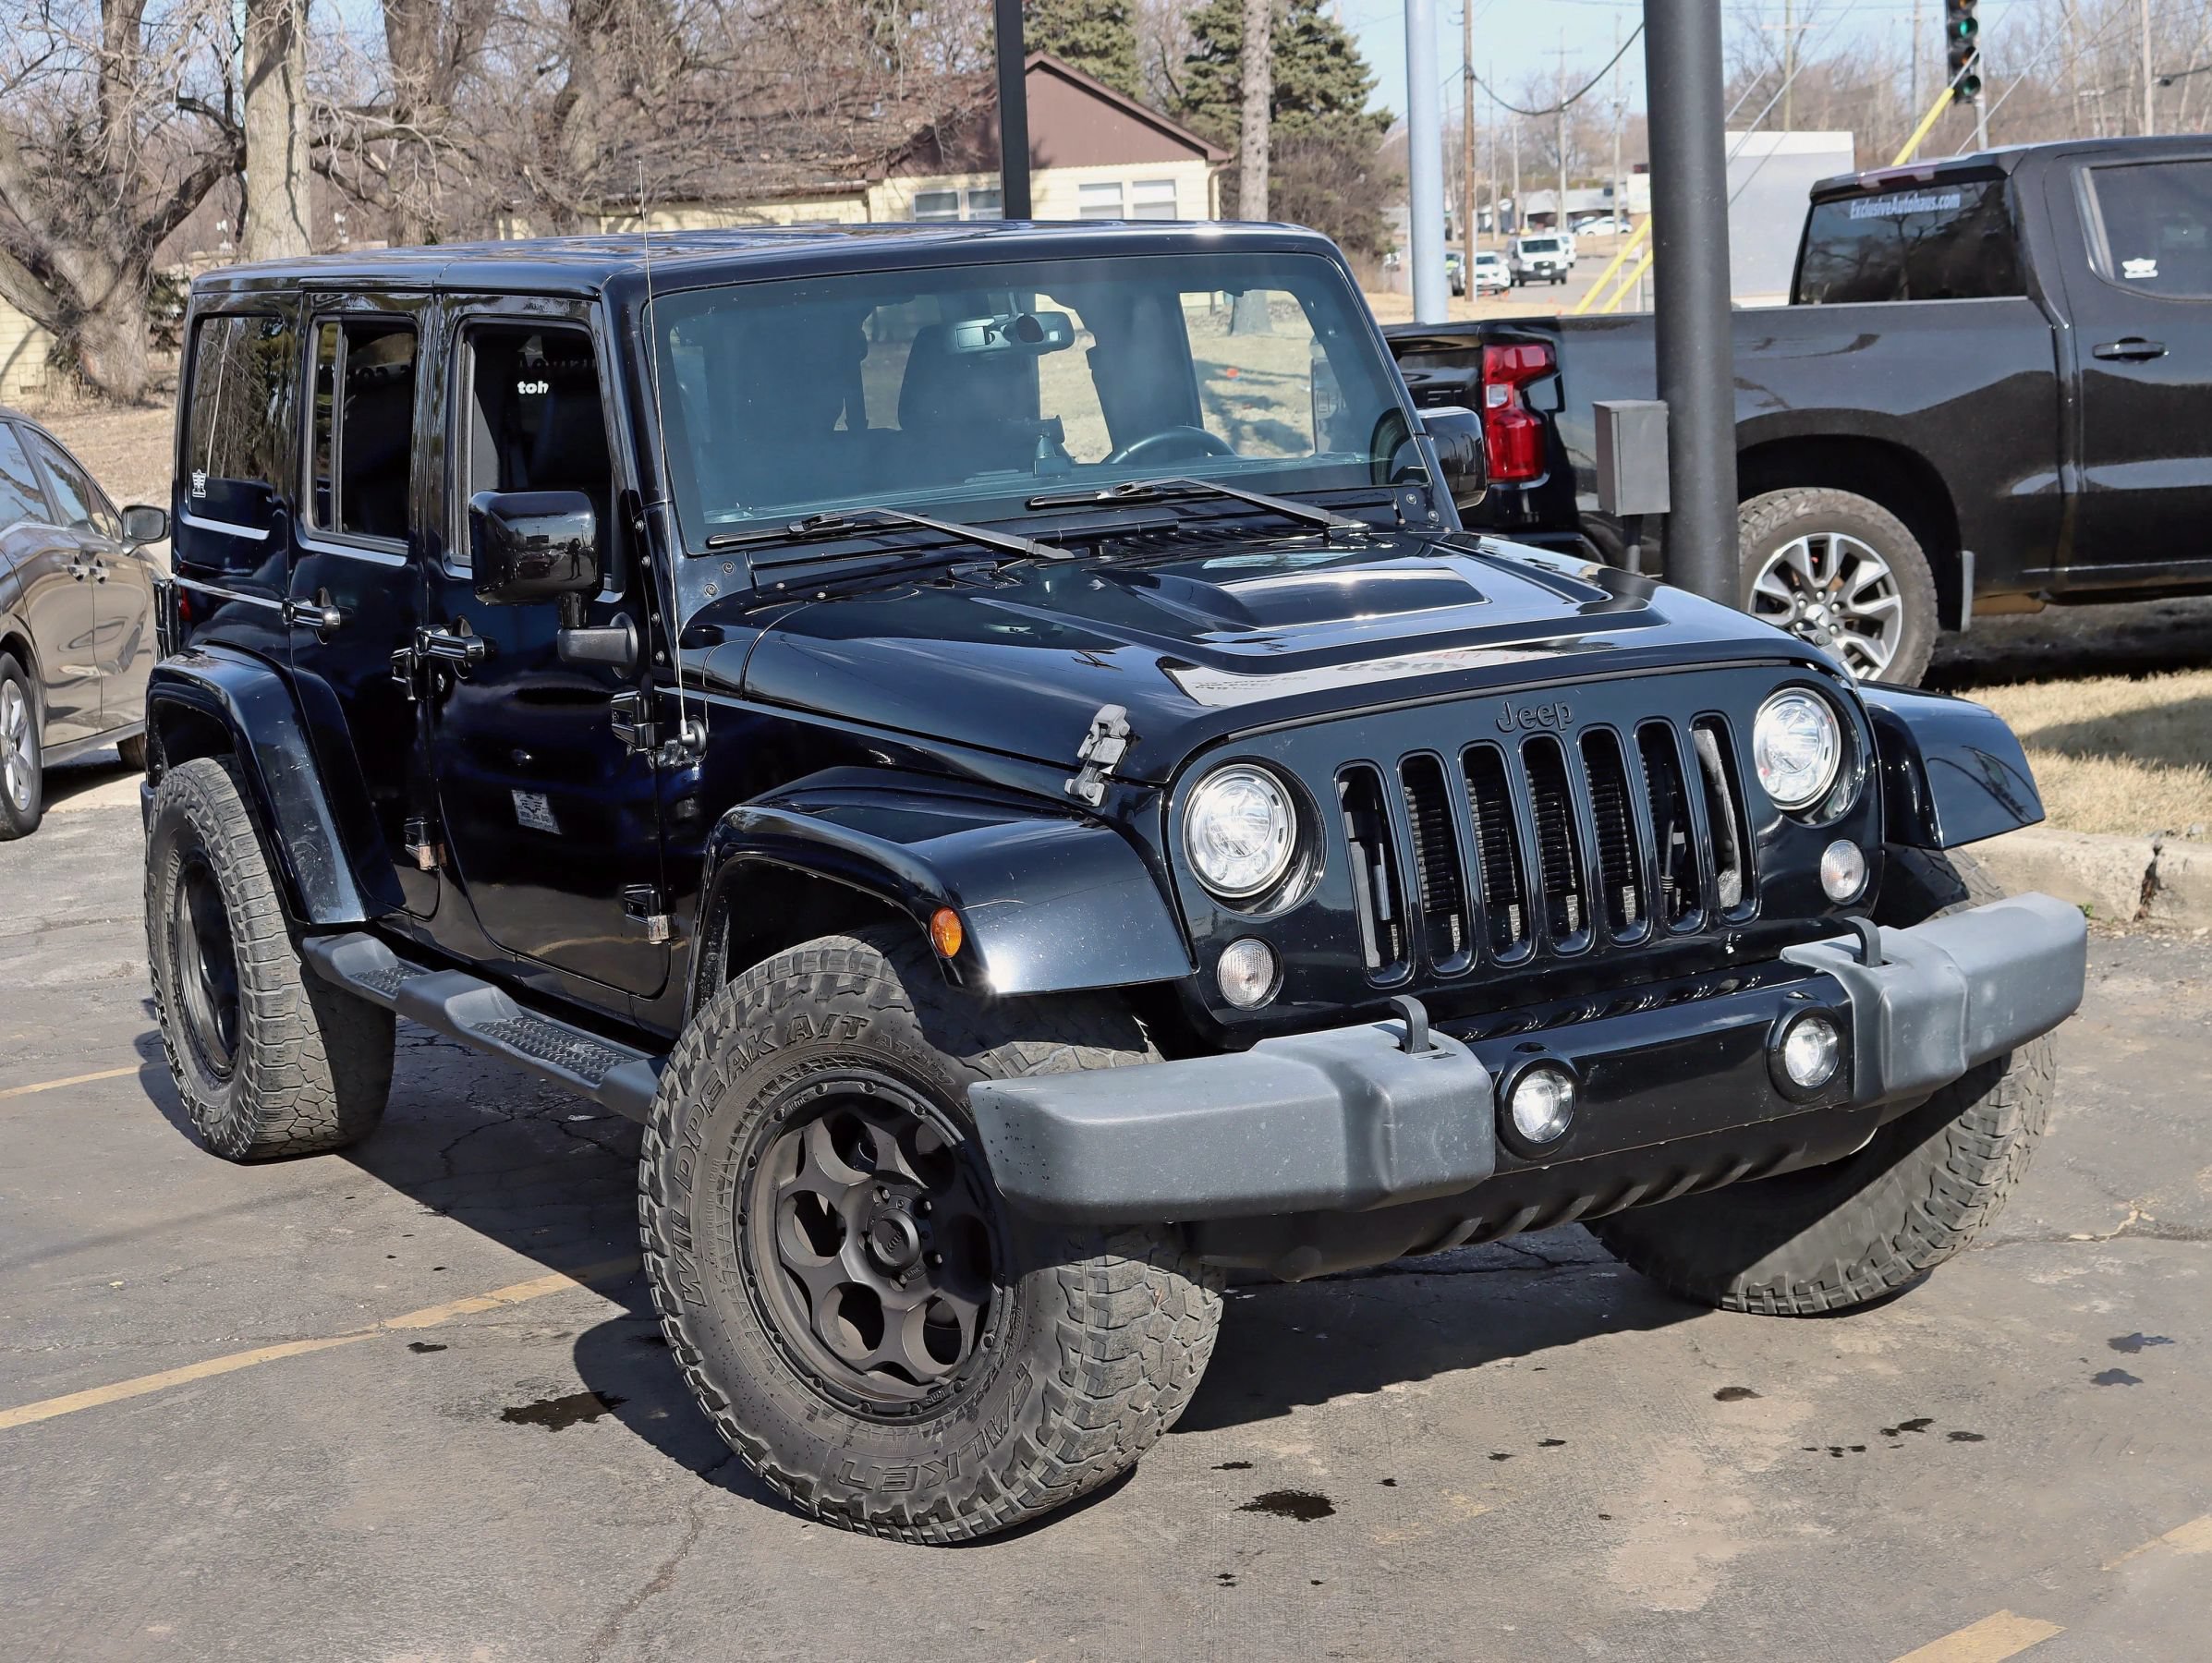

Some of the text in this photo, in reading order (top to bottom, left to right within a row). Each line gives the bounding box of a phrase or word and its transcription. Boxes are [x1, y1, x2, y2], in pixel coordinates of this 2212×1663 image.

[1850, 192, 1961, 220] ExclusiveAutohaus.com
[1495, 700, 1575, 734] Jeep
[671, 1012, 870, 1307] WILDPEAK A/T
[837, 1358, 1033, 1493] FALKEN
